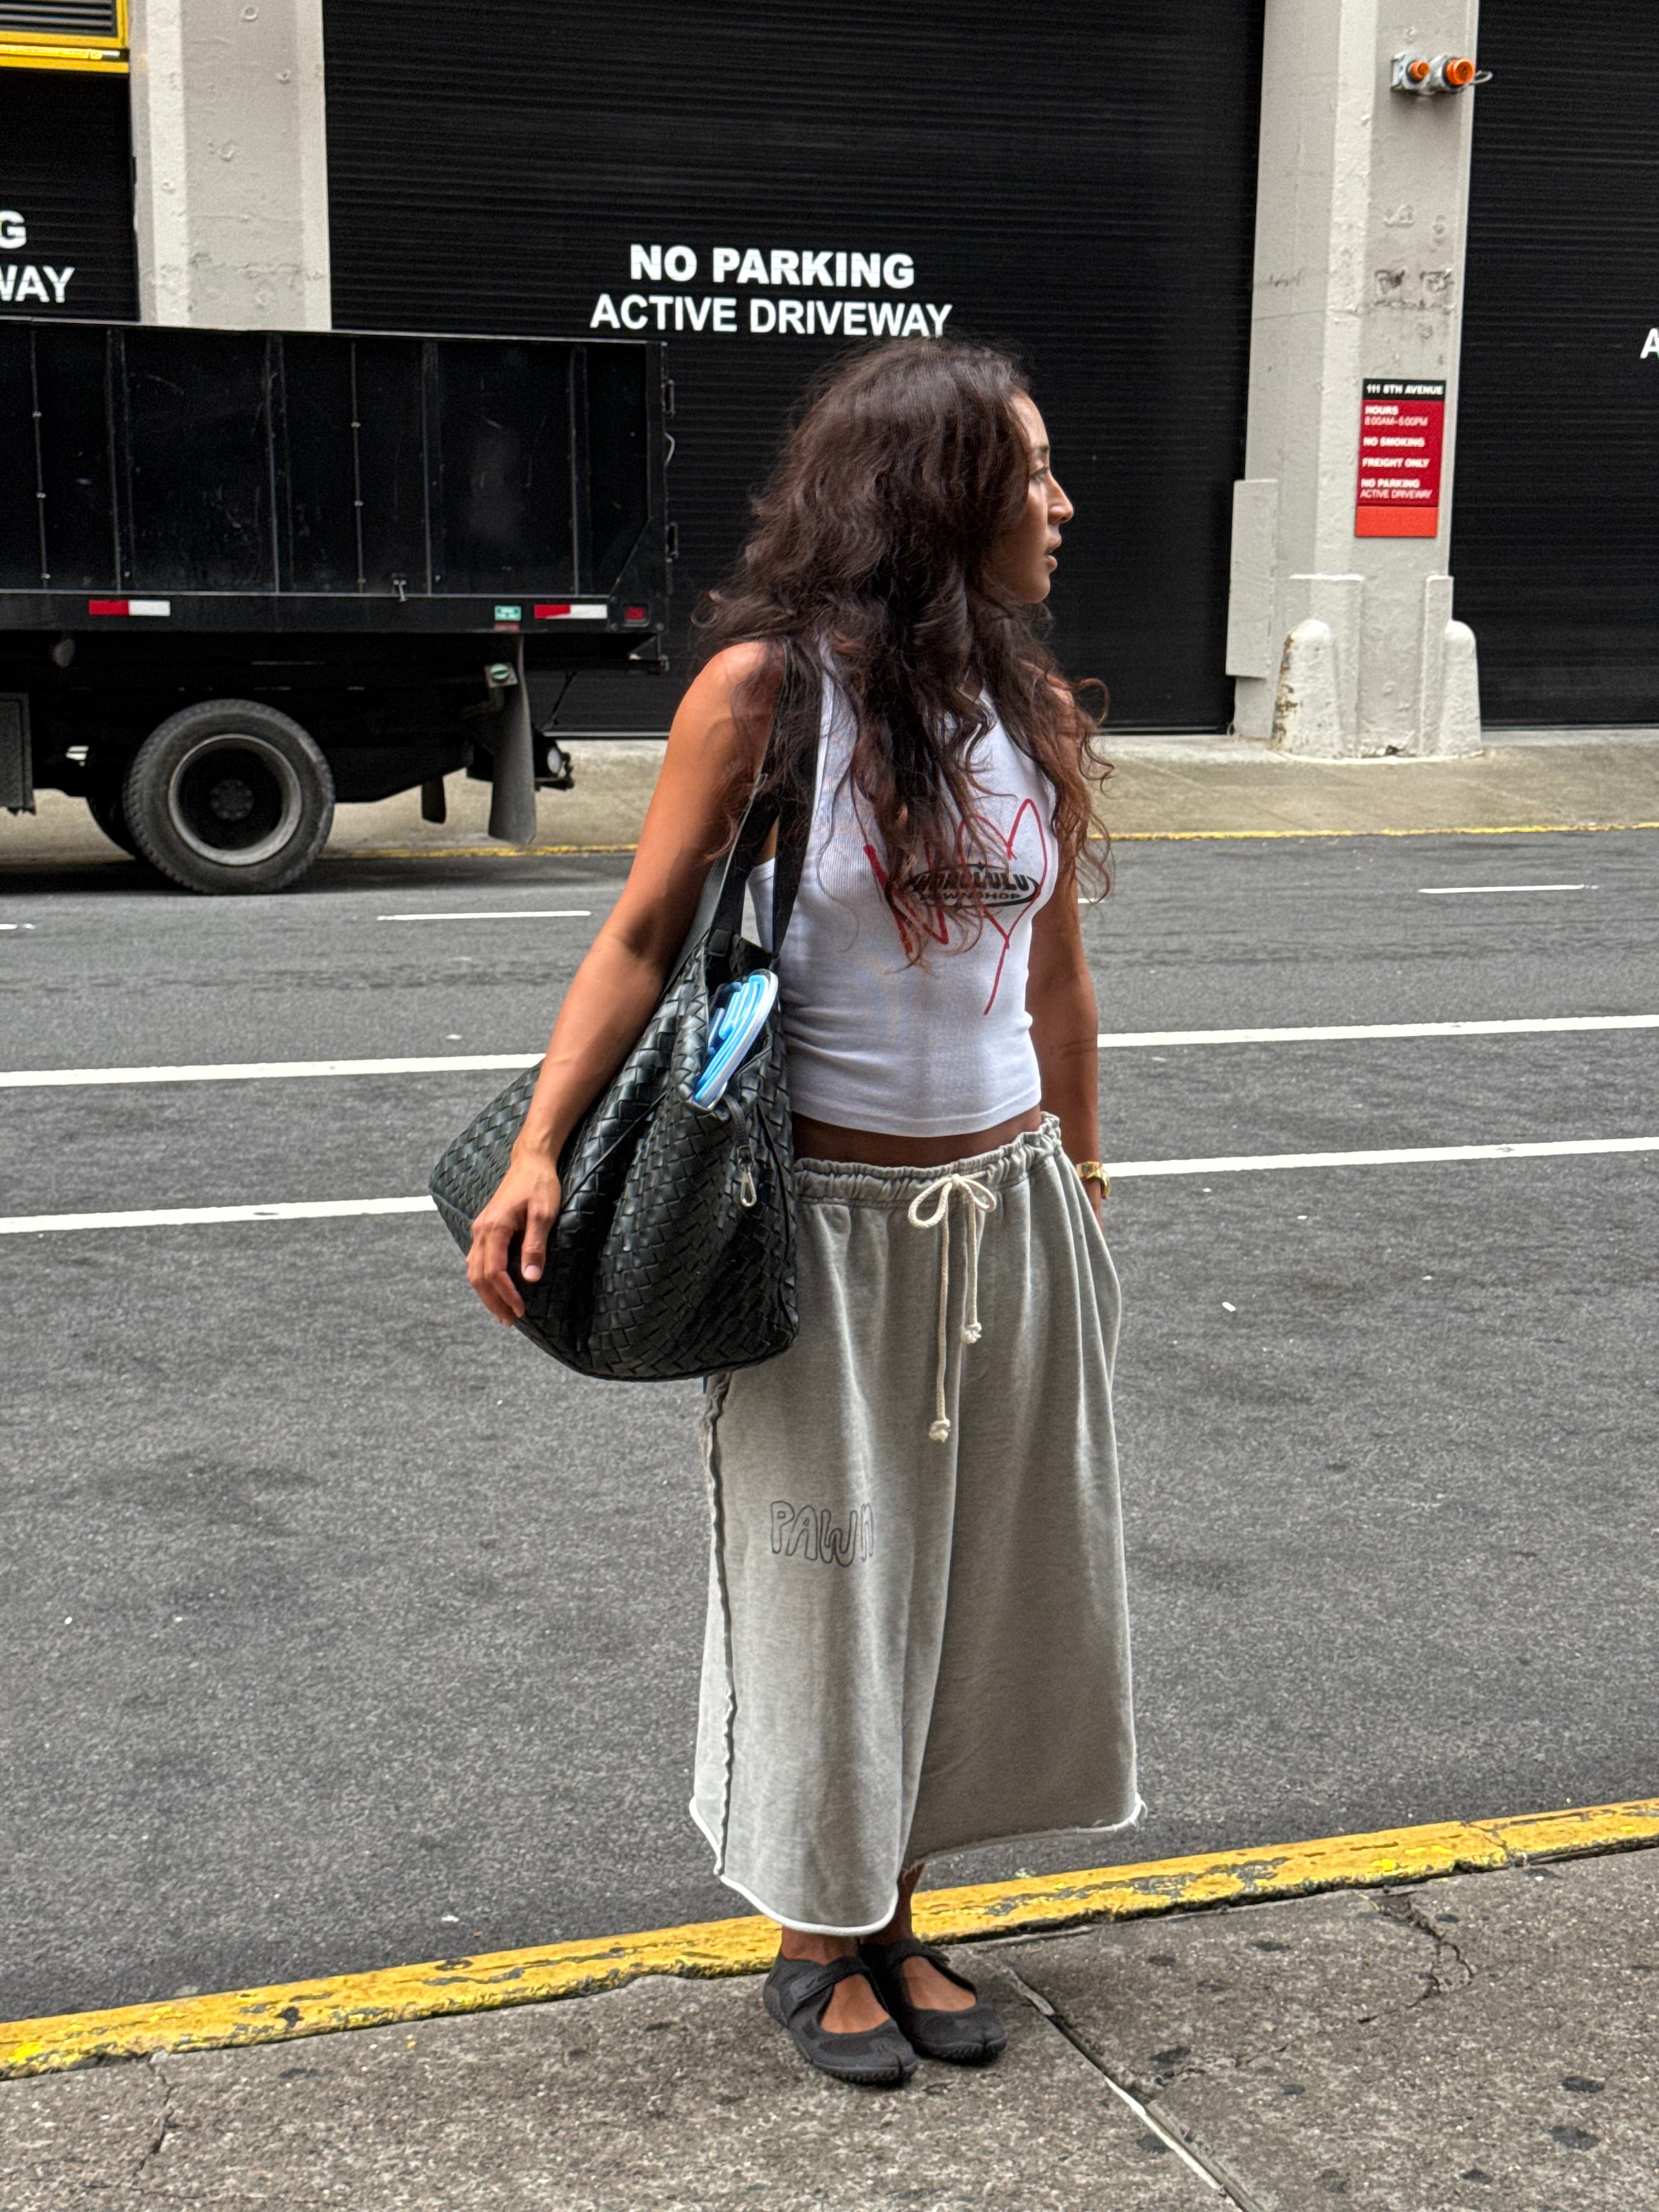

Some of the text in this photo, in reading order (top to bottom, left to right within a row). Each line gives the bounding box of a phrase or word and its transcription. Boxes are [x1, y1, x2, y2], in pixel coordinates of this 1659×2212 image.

[630, 244, 915, 289] NO PARKING
[590, 294, 952, 337] ACTIVE DRIVEWAY
[1366, 384, 1443, 395] 111 8TH AVENUE
[1365, 405, 1399, 415] HOURS
[1363, 437, 1425, 447] NO SMOKING
[1362, 458, 1430, 468] FREIGHT ONLY
[1361, 478, 1420, 488] NO PARKING
[1360, 489, 1432, 499] ACTIVE DRIVEWAY
